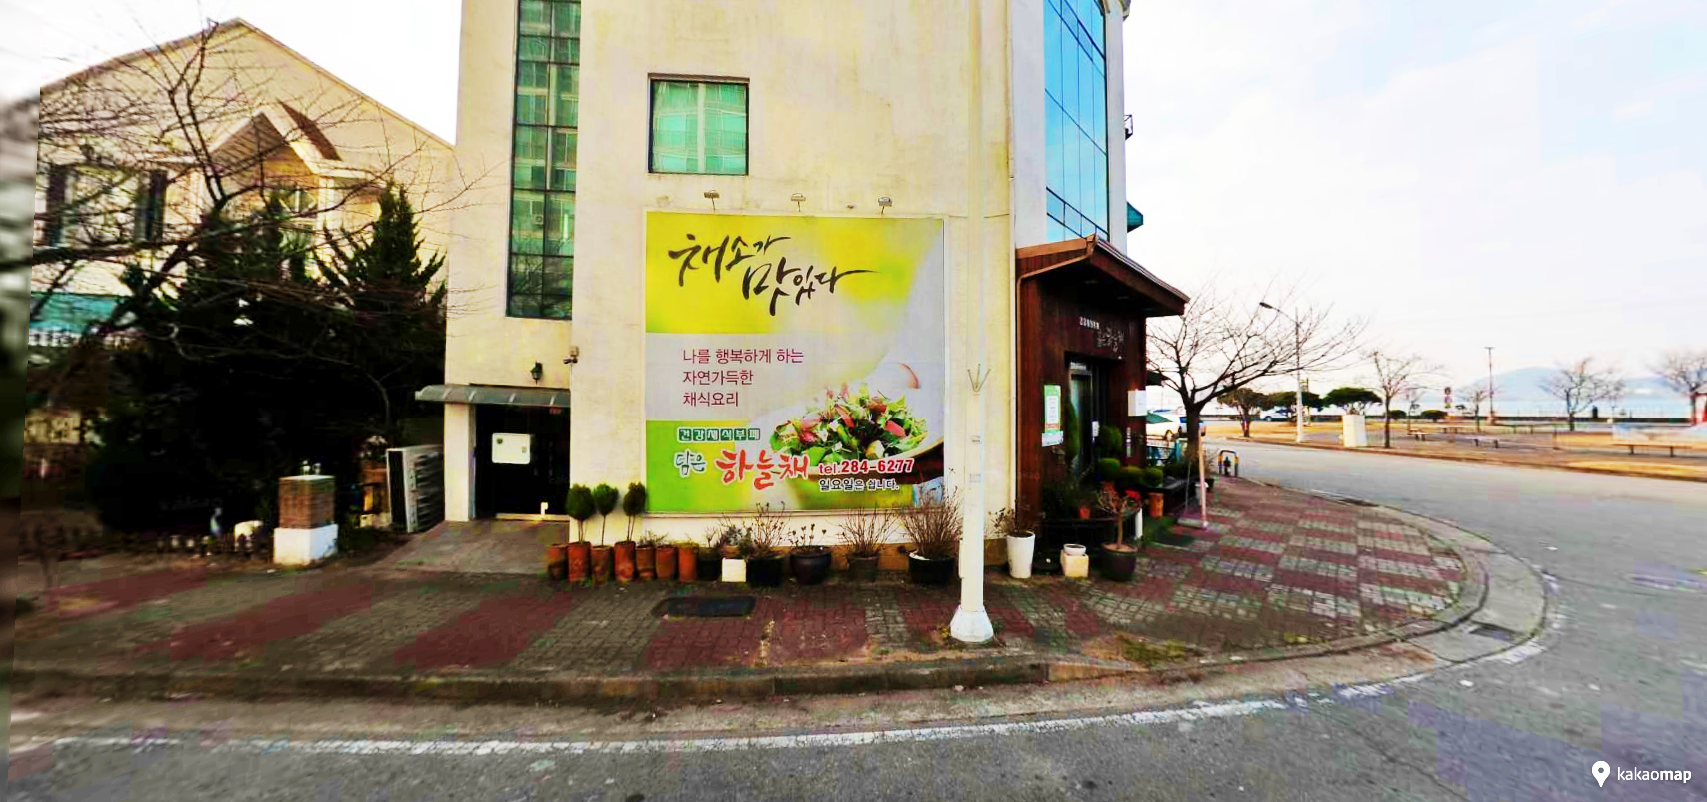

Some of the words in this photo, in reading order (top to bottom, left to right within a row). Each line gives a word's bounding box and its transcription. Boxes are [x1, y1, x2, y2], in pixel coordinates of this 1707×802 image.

[668, 234, 791, 287] 채소가
[742, 257, 879, 316] 맛있다
[683, 348, 711, 364] 나를
[715, 349, 771, 364] 행복하게
[776, 349, 804, 364] 하는
[683, 370, 754, 385] 자연가득한
[683, 391, 739, 407] 채식요리
[716, 449, 808, 490] 하늘채
[820, 480, 864, 491] 일요일은
